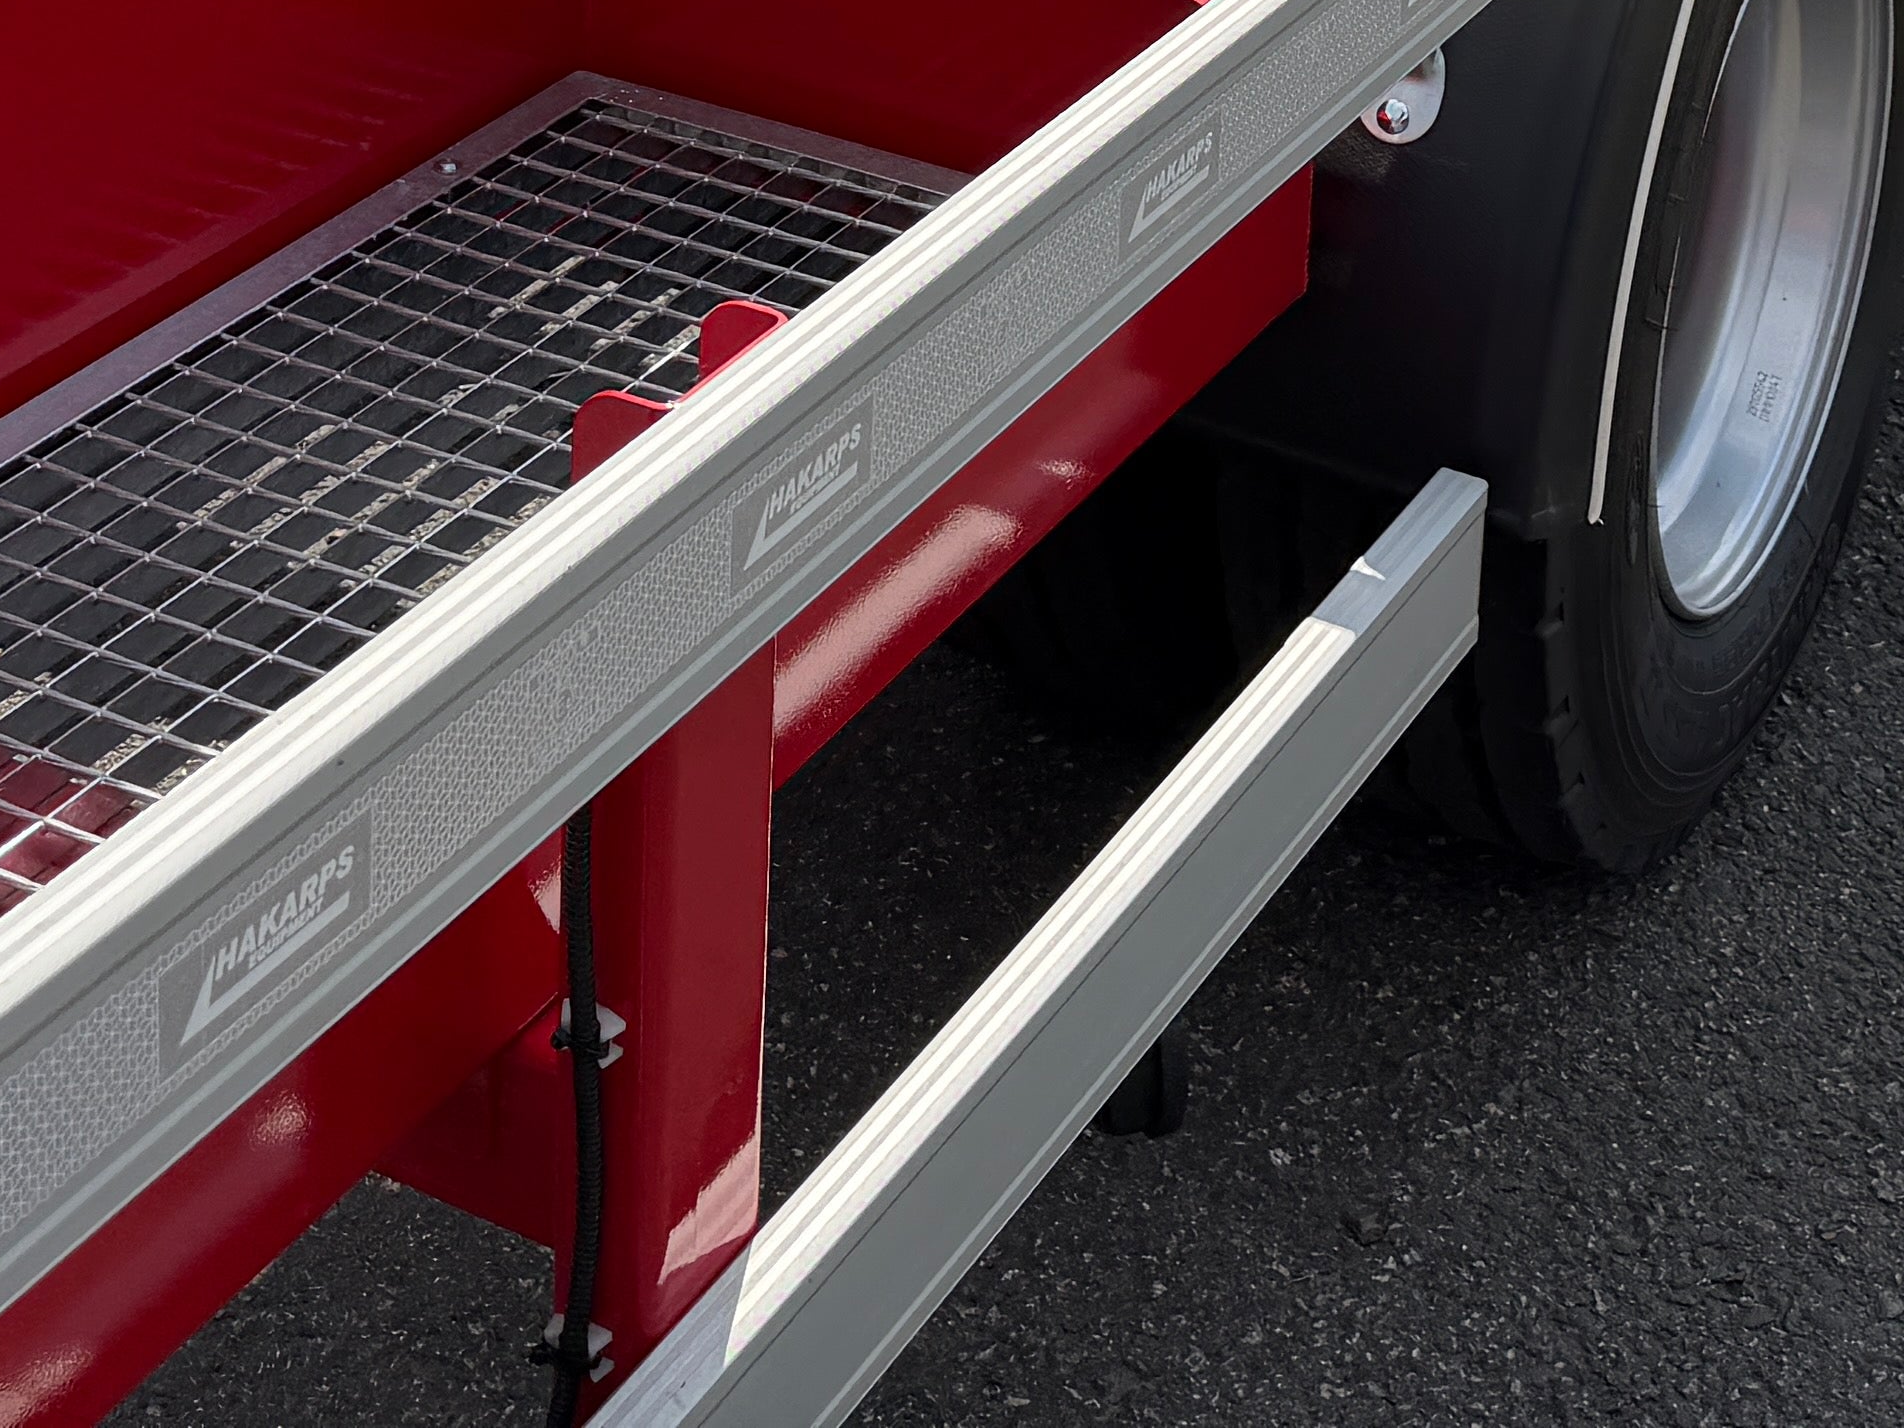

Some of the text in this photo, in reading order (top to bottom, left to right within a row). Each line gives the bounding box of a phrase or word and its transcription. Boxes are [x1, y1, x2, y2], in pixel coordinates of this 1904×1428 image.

[1146, 131, 1213, 203] HAKARPS
[768, 423, 862, 520] HAKARPS
[215, 845, 355, 981] HAKARPS
[248, 896, 324, 969] EQUIPMENT
